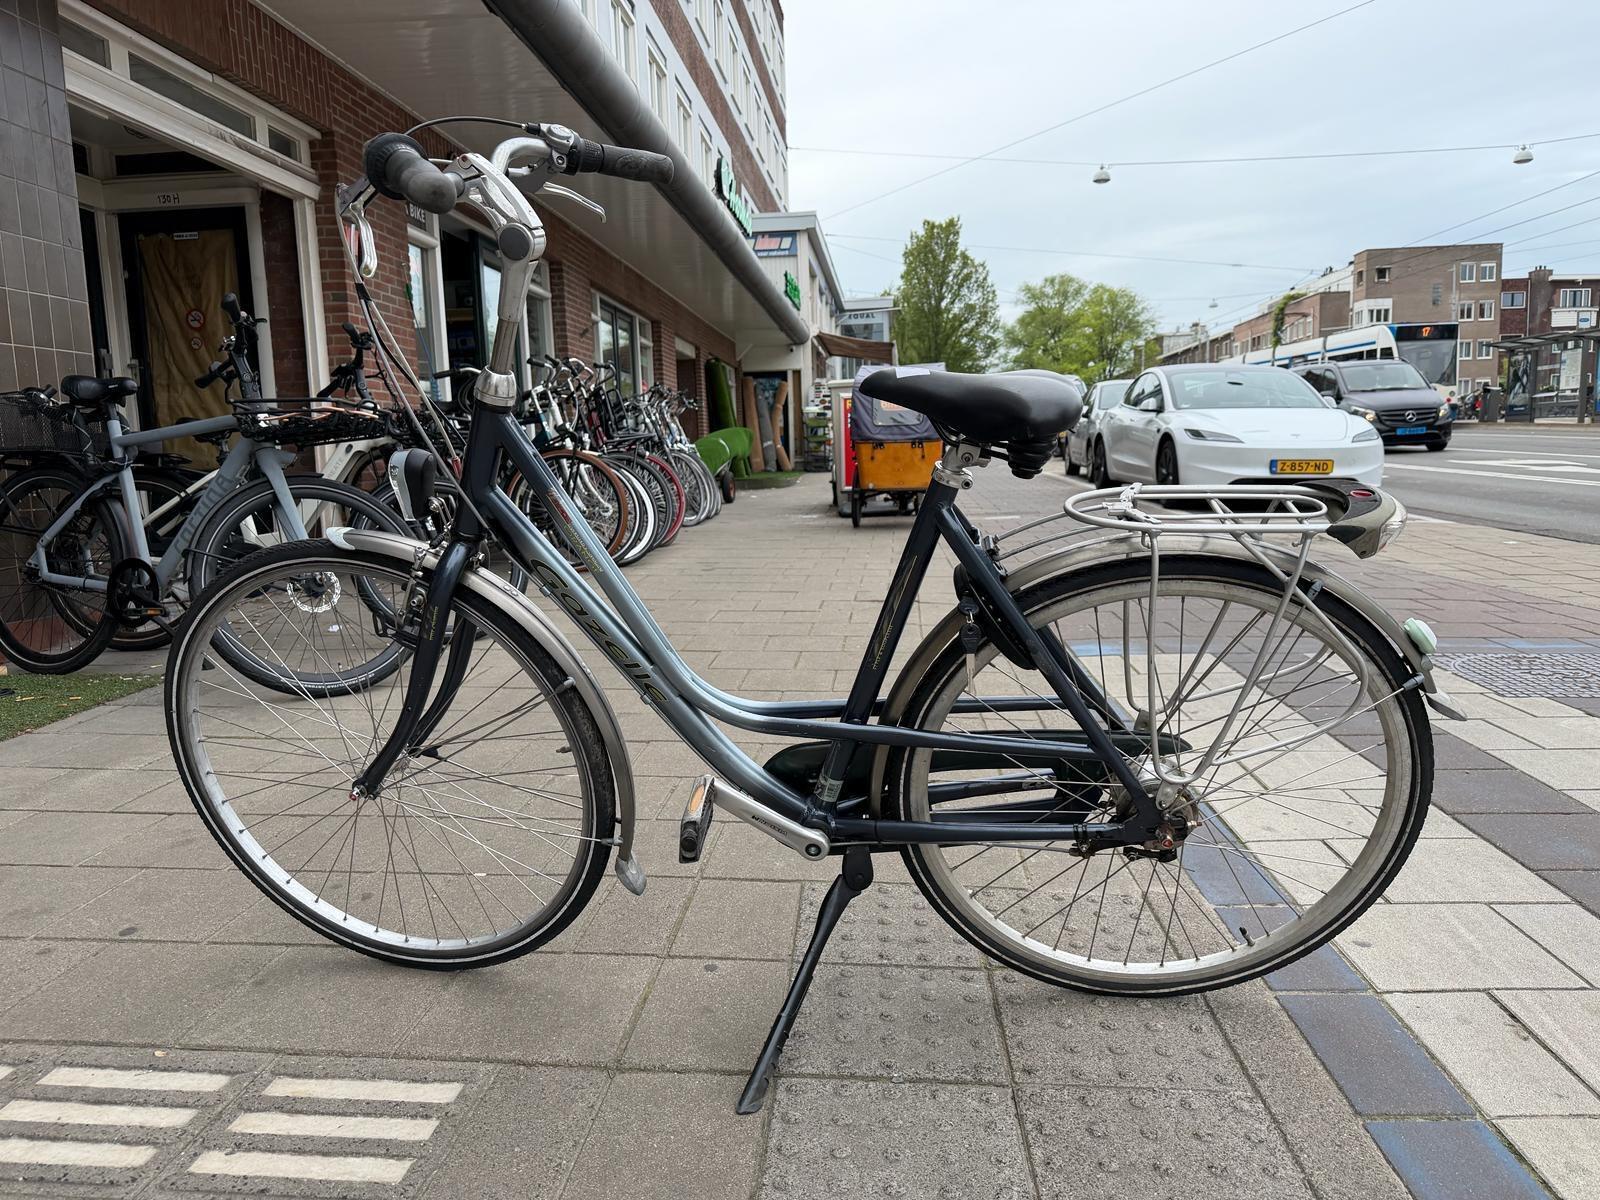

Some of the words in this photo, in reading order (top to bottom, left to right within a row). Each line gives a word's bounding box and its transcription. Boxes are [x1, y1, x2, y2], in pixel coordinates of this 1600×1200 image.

[1422, 327, 1432, 337] 17
[1280, 462, 1329, 472] Z-857-ND
[530, 559, 668, 701] Gazelle
